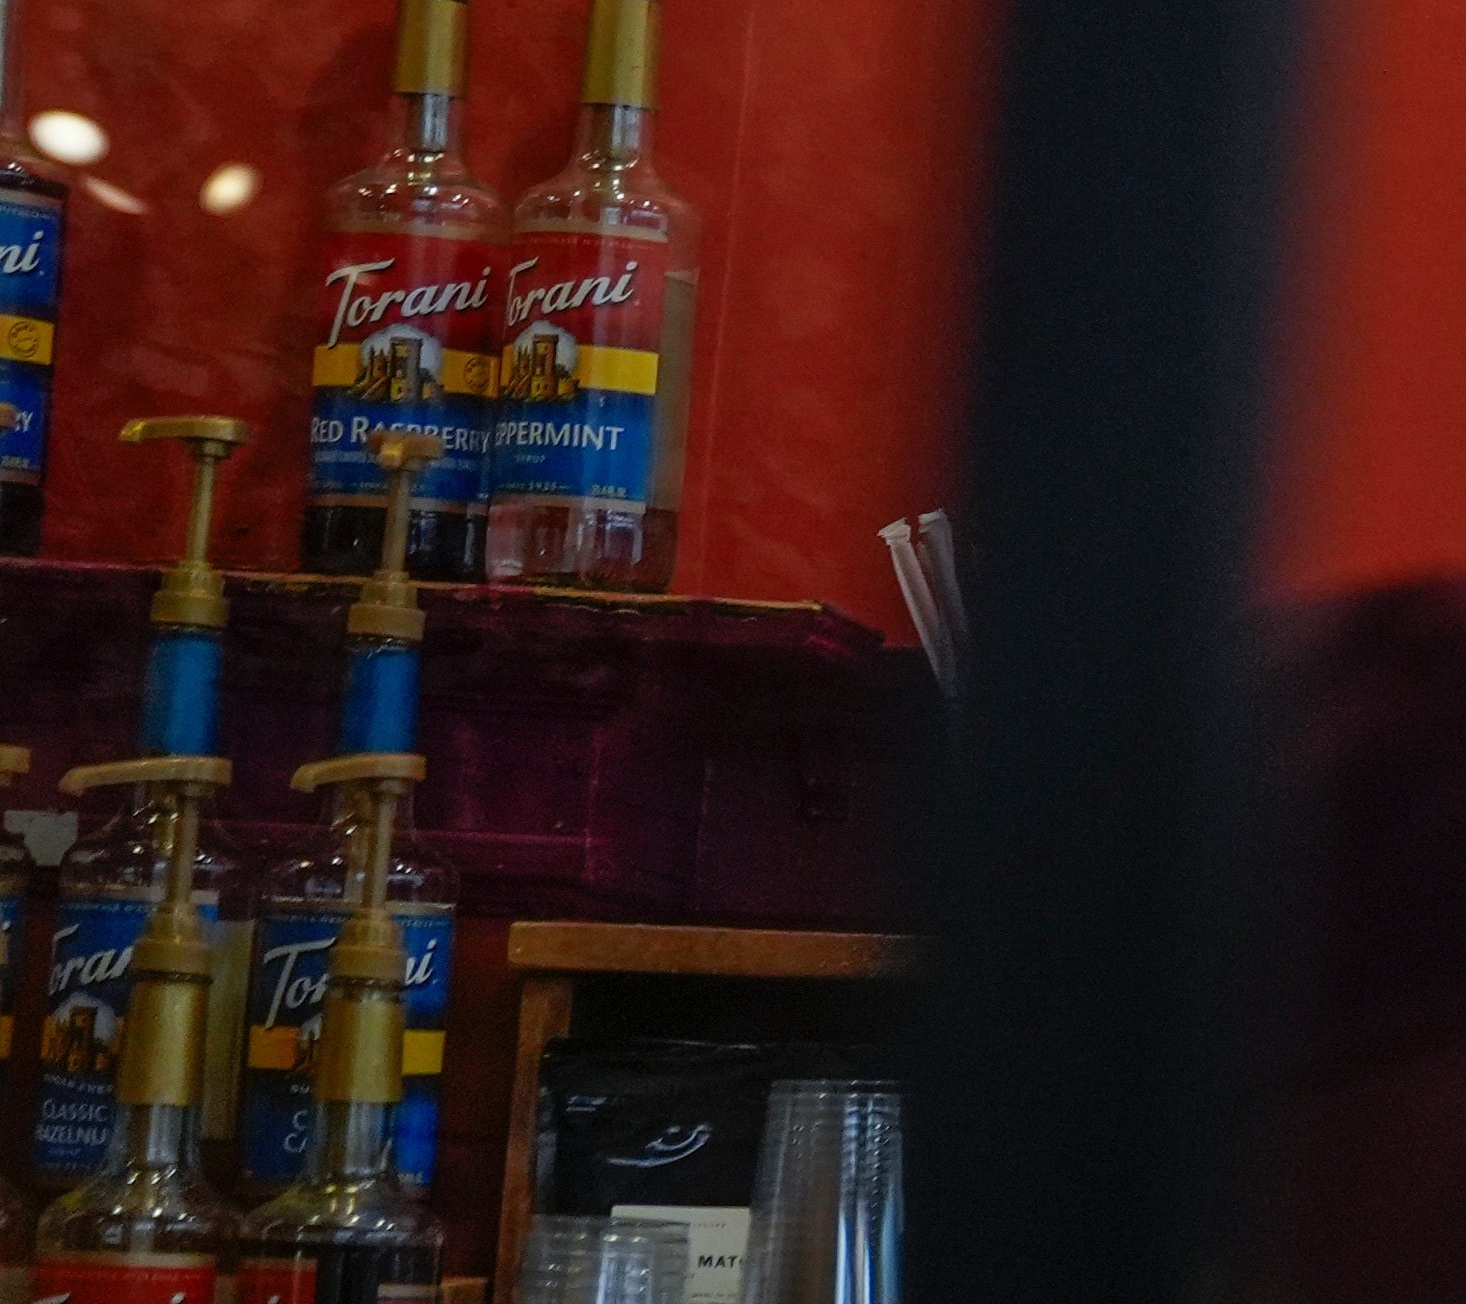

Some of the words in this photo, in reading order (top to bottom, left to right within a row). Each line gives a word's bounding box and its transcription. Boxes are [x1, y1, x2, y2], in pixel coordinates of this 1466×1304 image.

[326, 258, 492, 348] Torani
[506, 257, 639, 326] Torani
[310, 417, 344, 444] RED
[495, 421, 625, 451] PPERMINT
[50, 923, 135, 996] Tora
